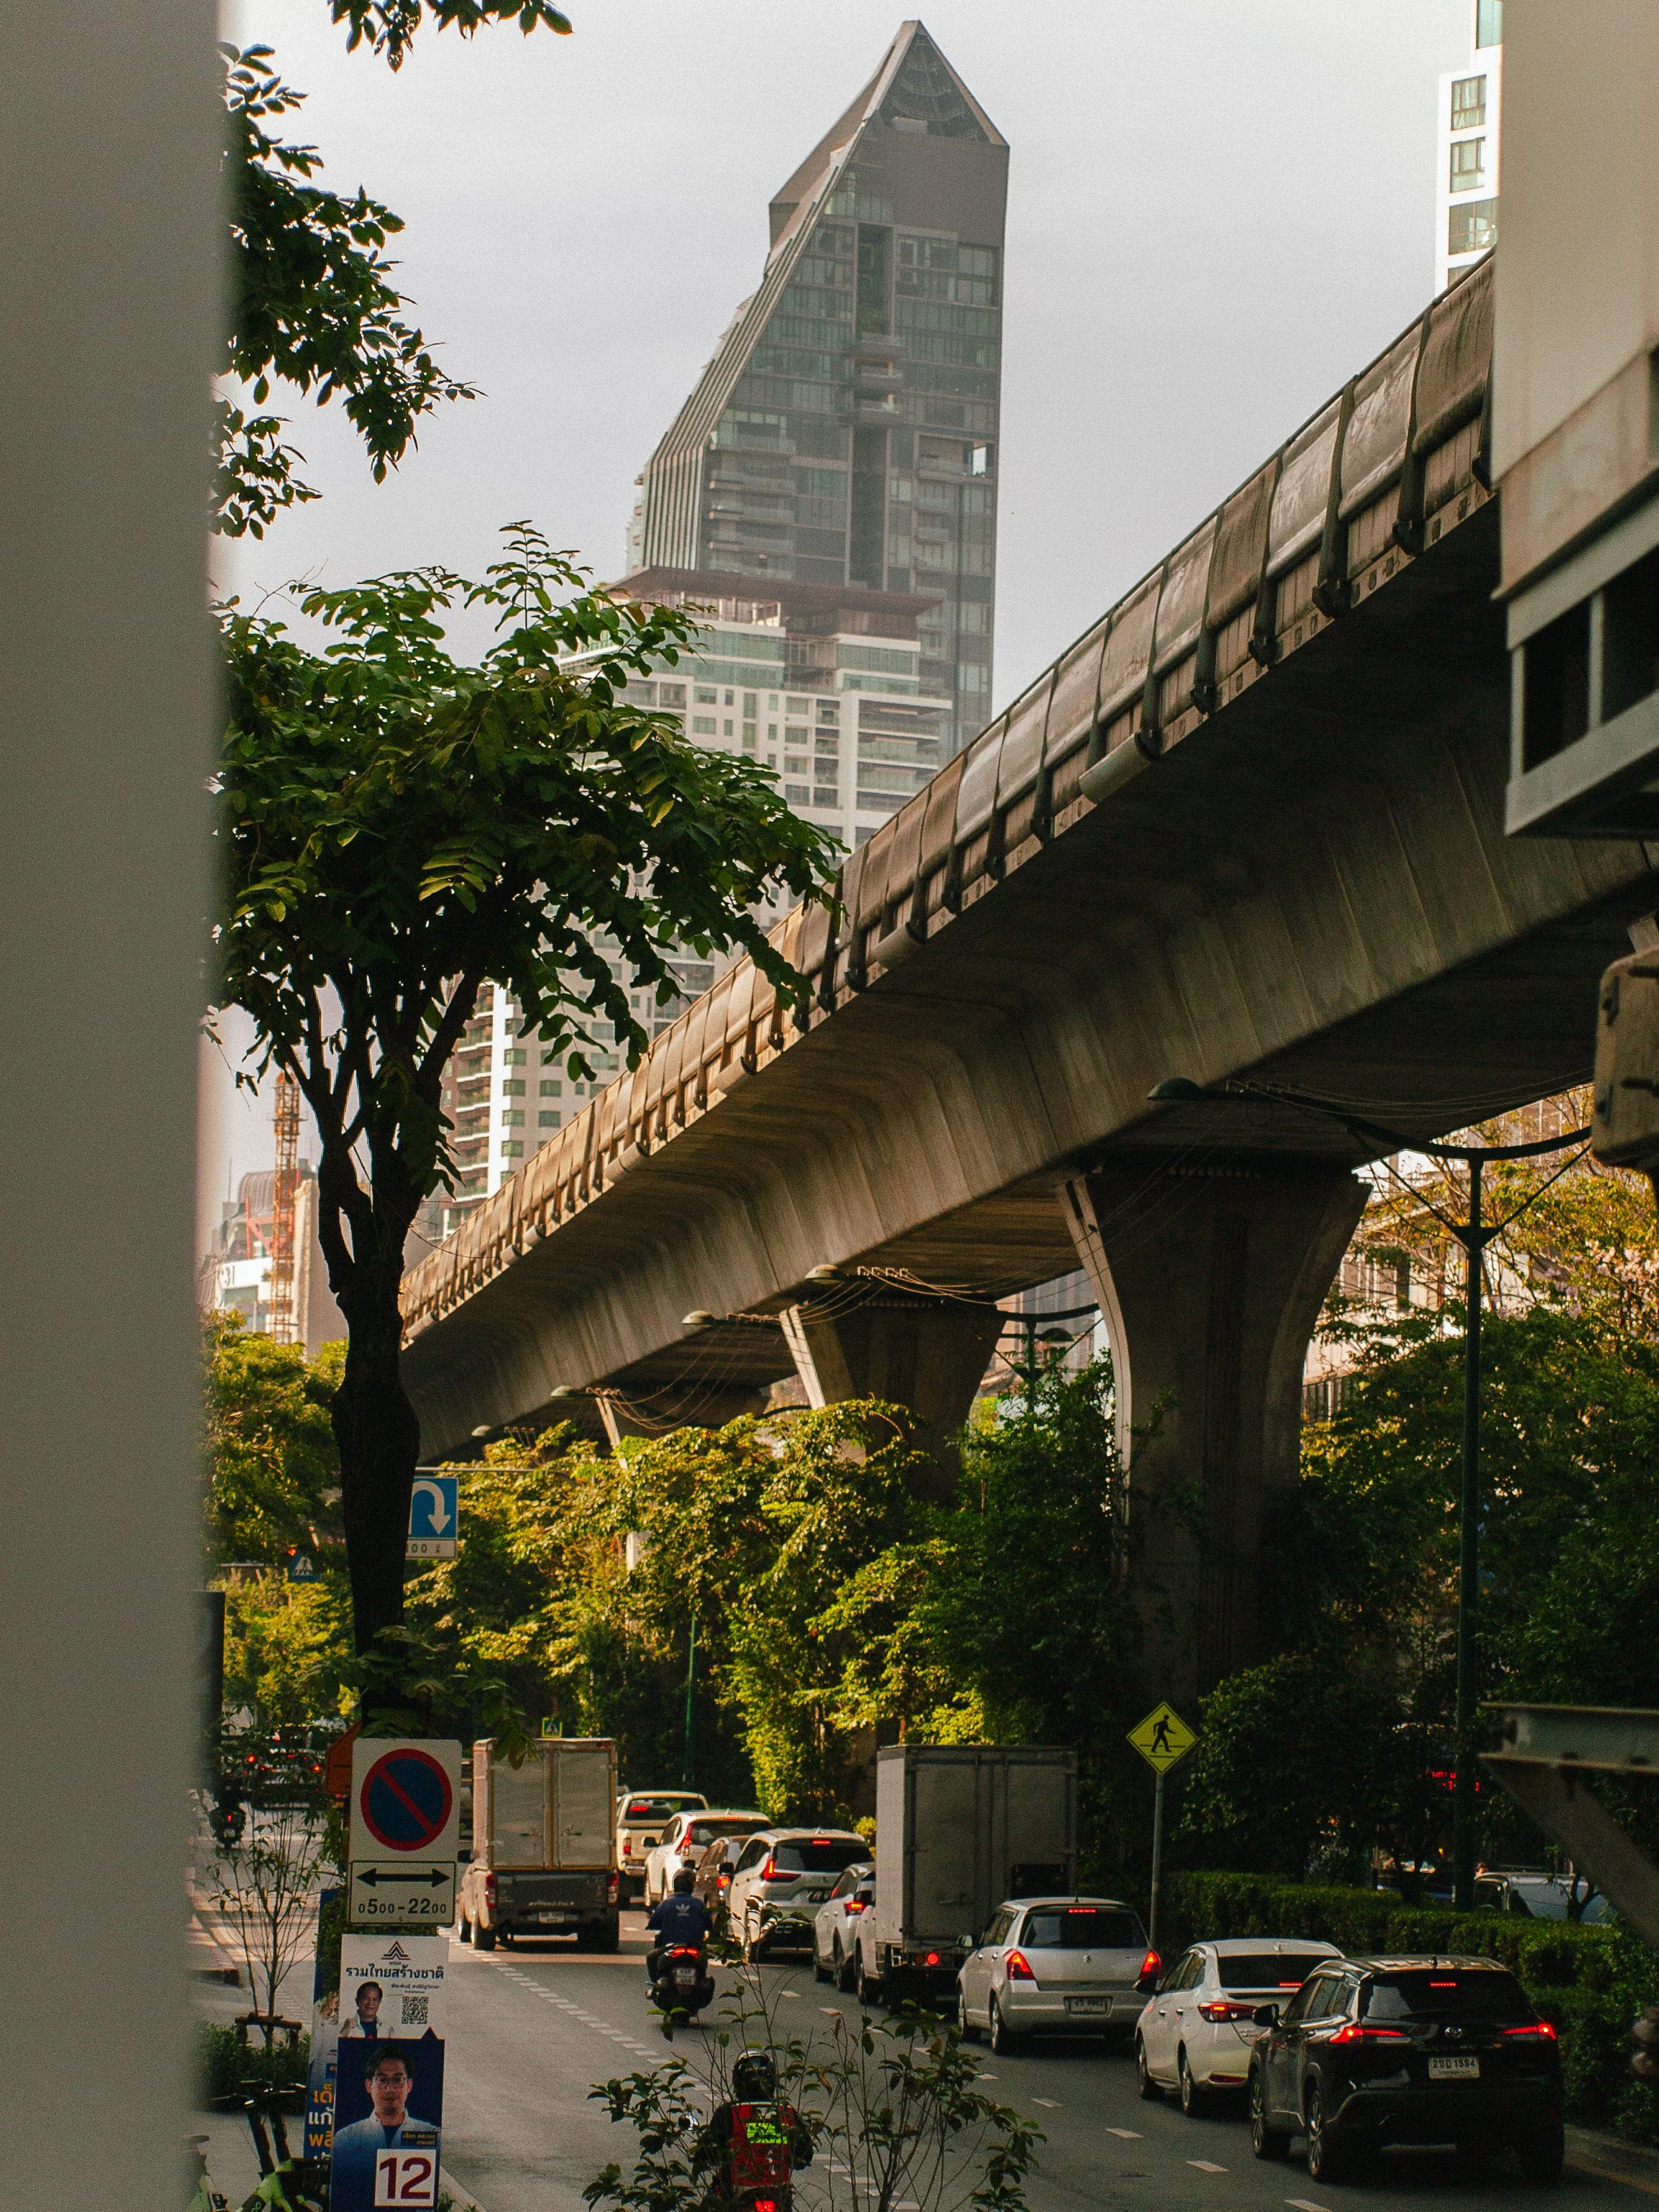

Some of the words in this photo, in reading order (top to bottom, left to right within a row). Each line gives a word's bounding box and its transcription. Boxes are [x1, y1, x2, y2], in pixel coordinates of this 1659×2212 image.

[405, 1543, 427, 1553] 00
[358, 1898, 447, 1914] 0500-2200
[346, 1963, 444, 1979] รวมไทยสร้างชาติ
[379, 2157, 432, 2199] 12
